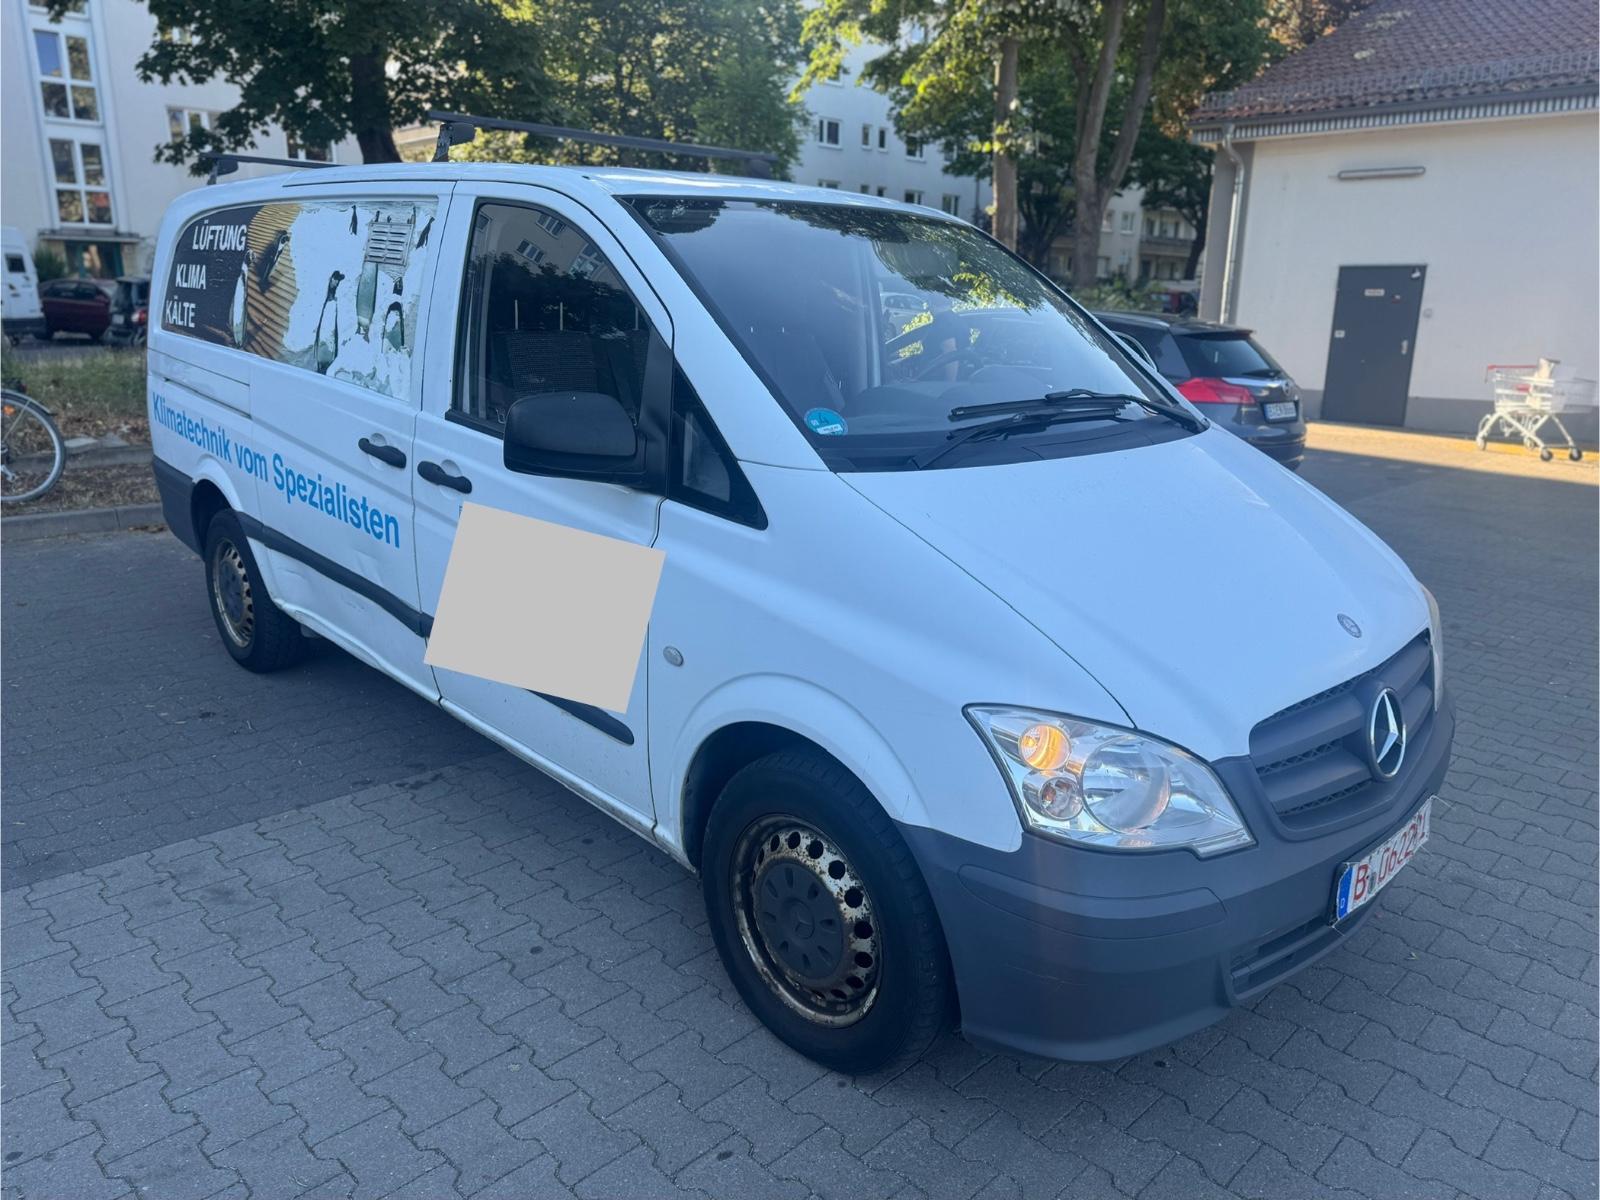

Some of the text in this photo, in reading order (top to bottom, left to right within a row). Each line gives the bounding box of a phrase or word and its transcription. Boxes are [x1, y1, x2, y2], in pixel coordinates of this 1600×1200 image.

[193, 219, 247, 251] LÜFTUNG
[175, 264, 207, 290] KLIMA
[165, 295, 196, 328] KÄLTE
[152, 391, 400, 548] Klimatechnik vom Spezialisten
